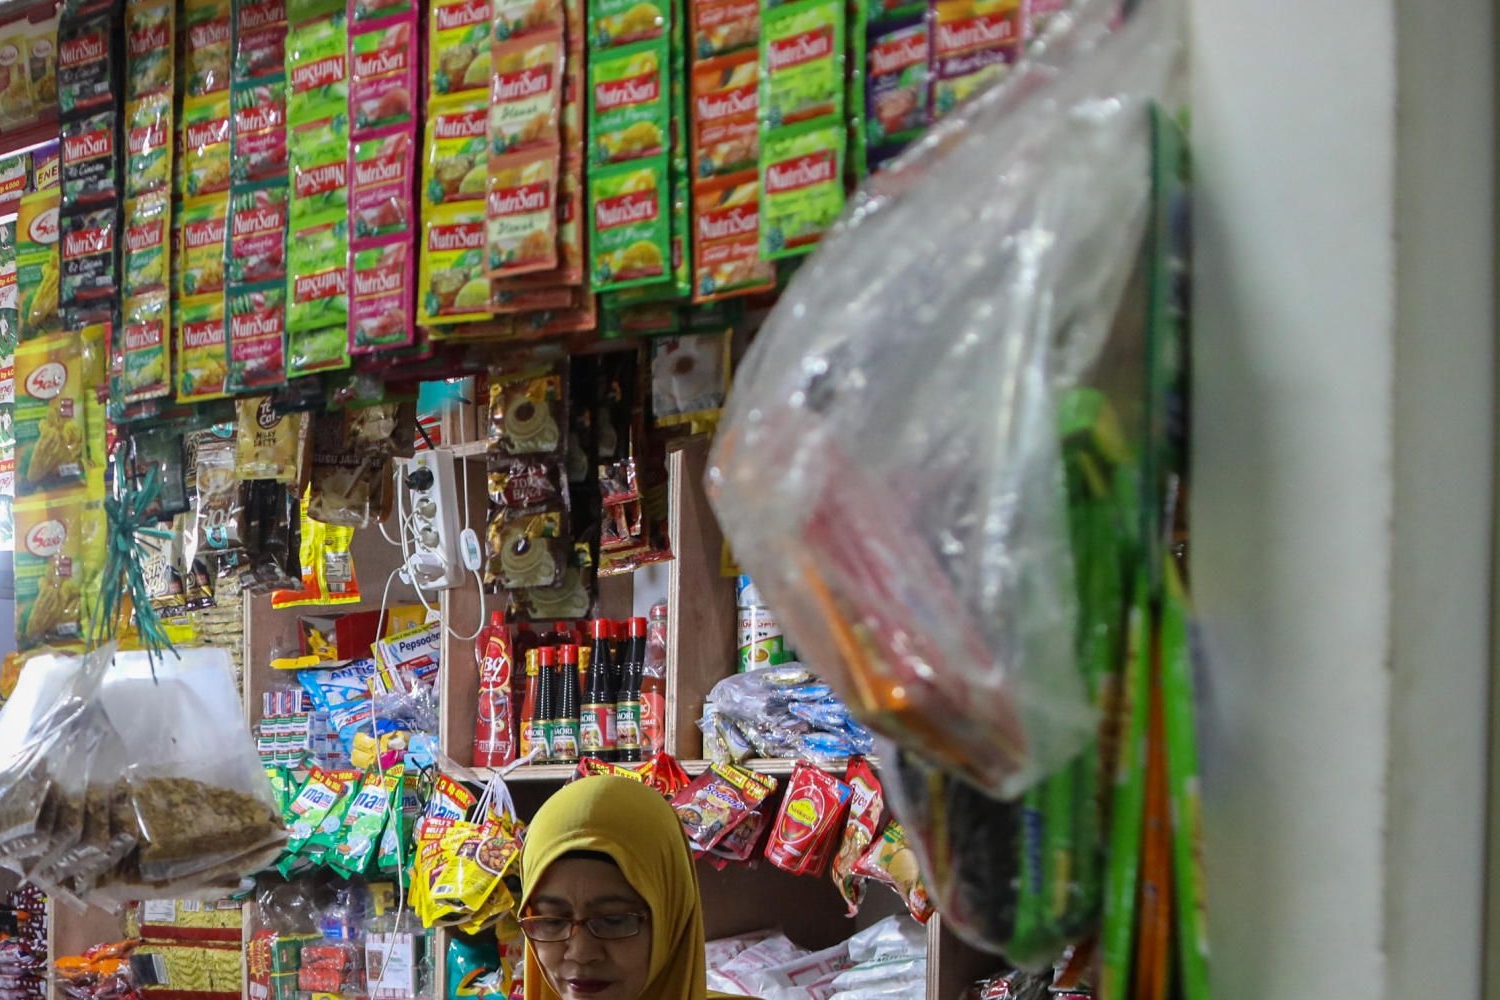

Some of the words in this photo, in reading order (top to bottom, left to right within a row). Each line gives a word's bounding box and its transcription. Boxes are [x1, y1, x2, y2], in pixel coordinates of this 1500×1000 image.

[938, 19, 1012, 48] NutriSari
[65, 137, 108, 159] NutriSari
[490, 191, 546, 214] NutriSari
[234, 211, 279, 236] NutriSari
[232, 315, 279, 340] NutriSari
